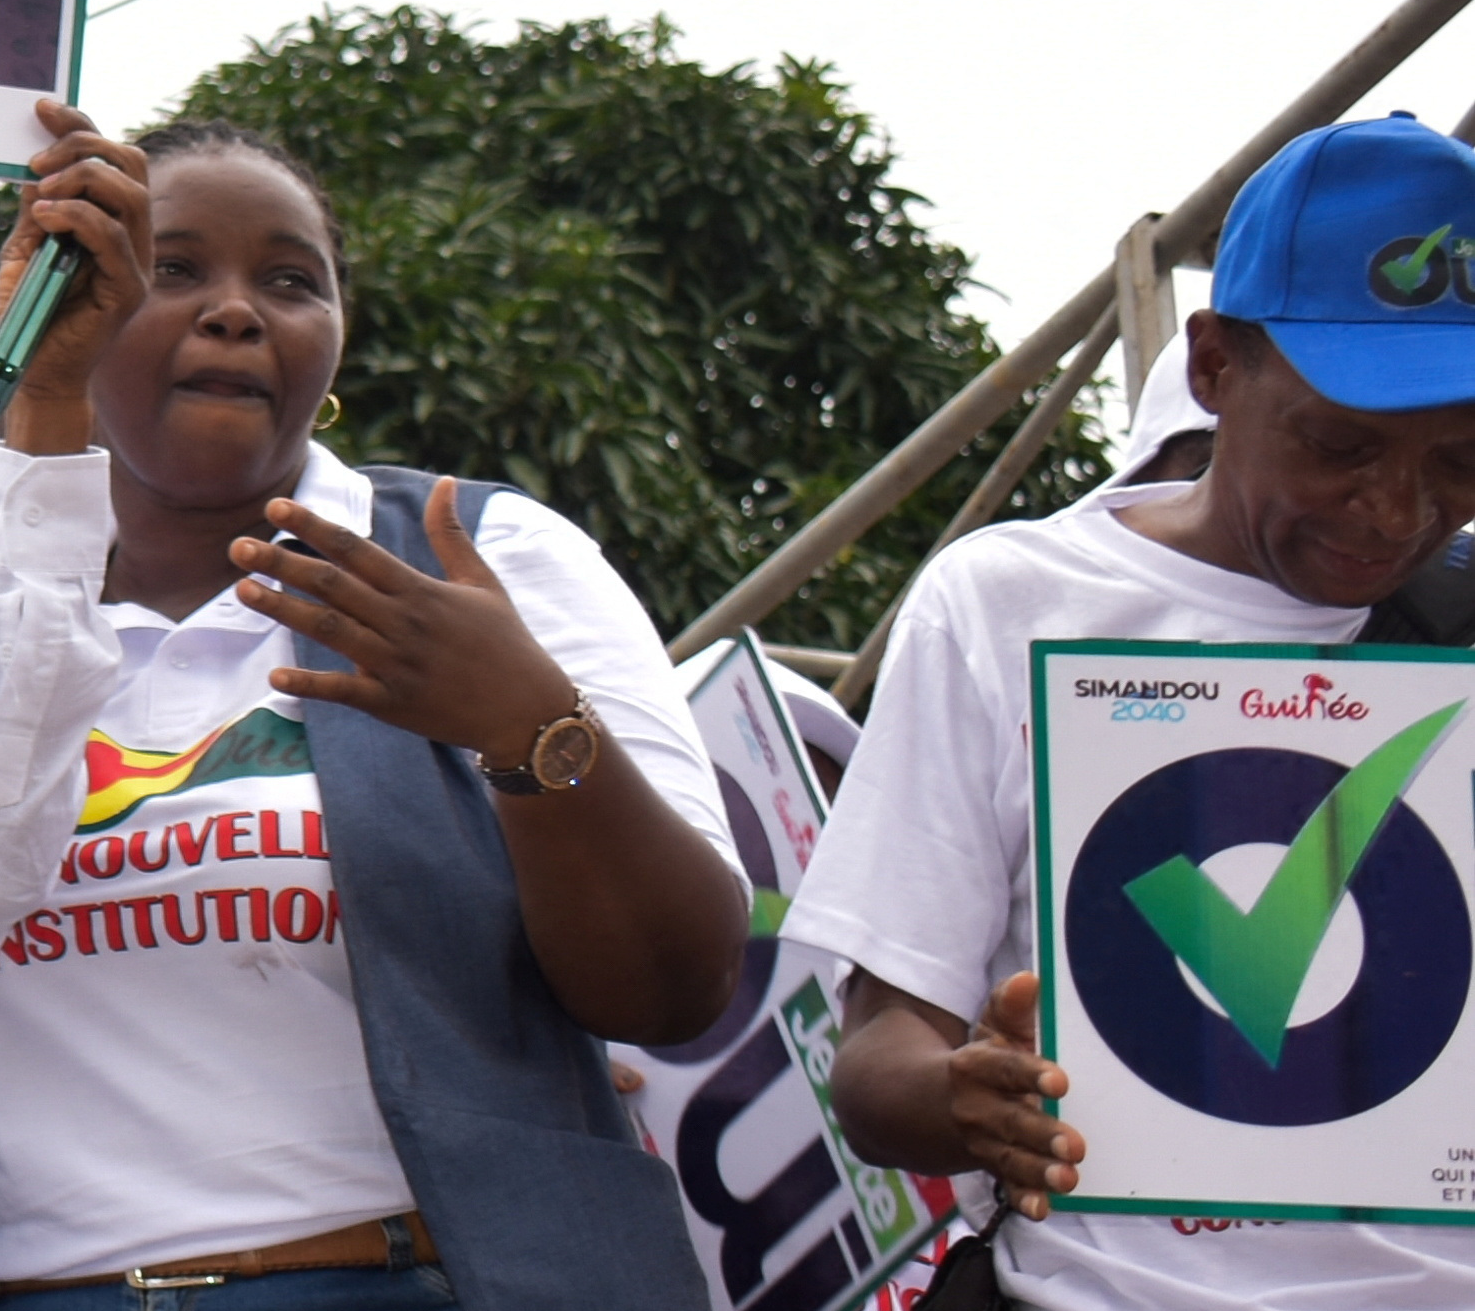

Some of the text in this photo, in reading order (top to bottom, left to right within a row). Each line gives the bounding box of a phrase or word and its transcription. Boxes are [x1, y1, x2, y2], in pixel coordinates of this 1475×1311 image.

[1074, 678, 1220, 701] SIMANDOU
[1110, 699, 1187, 723] 2040
[1431, 1168, 1465, 1182] QUI
[1442, 1188, 1465, 1201] ET
